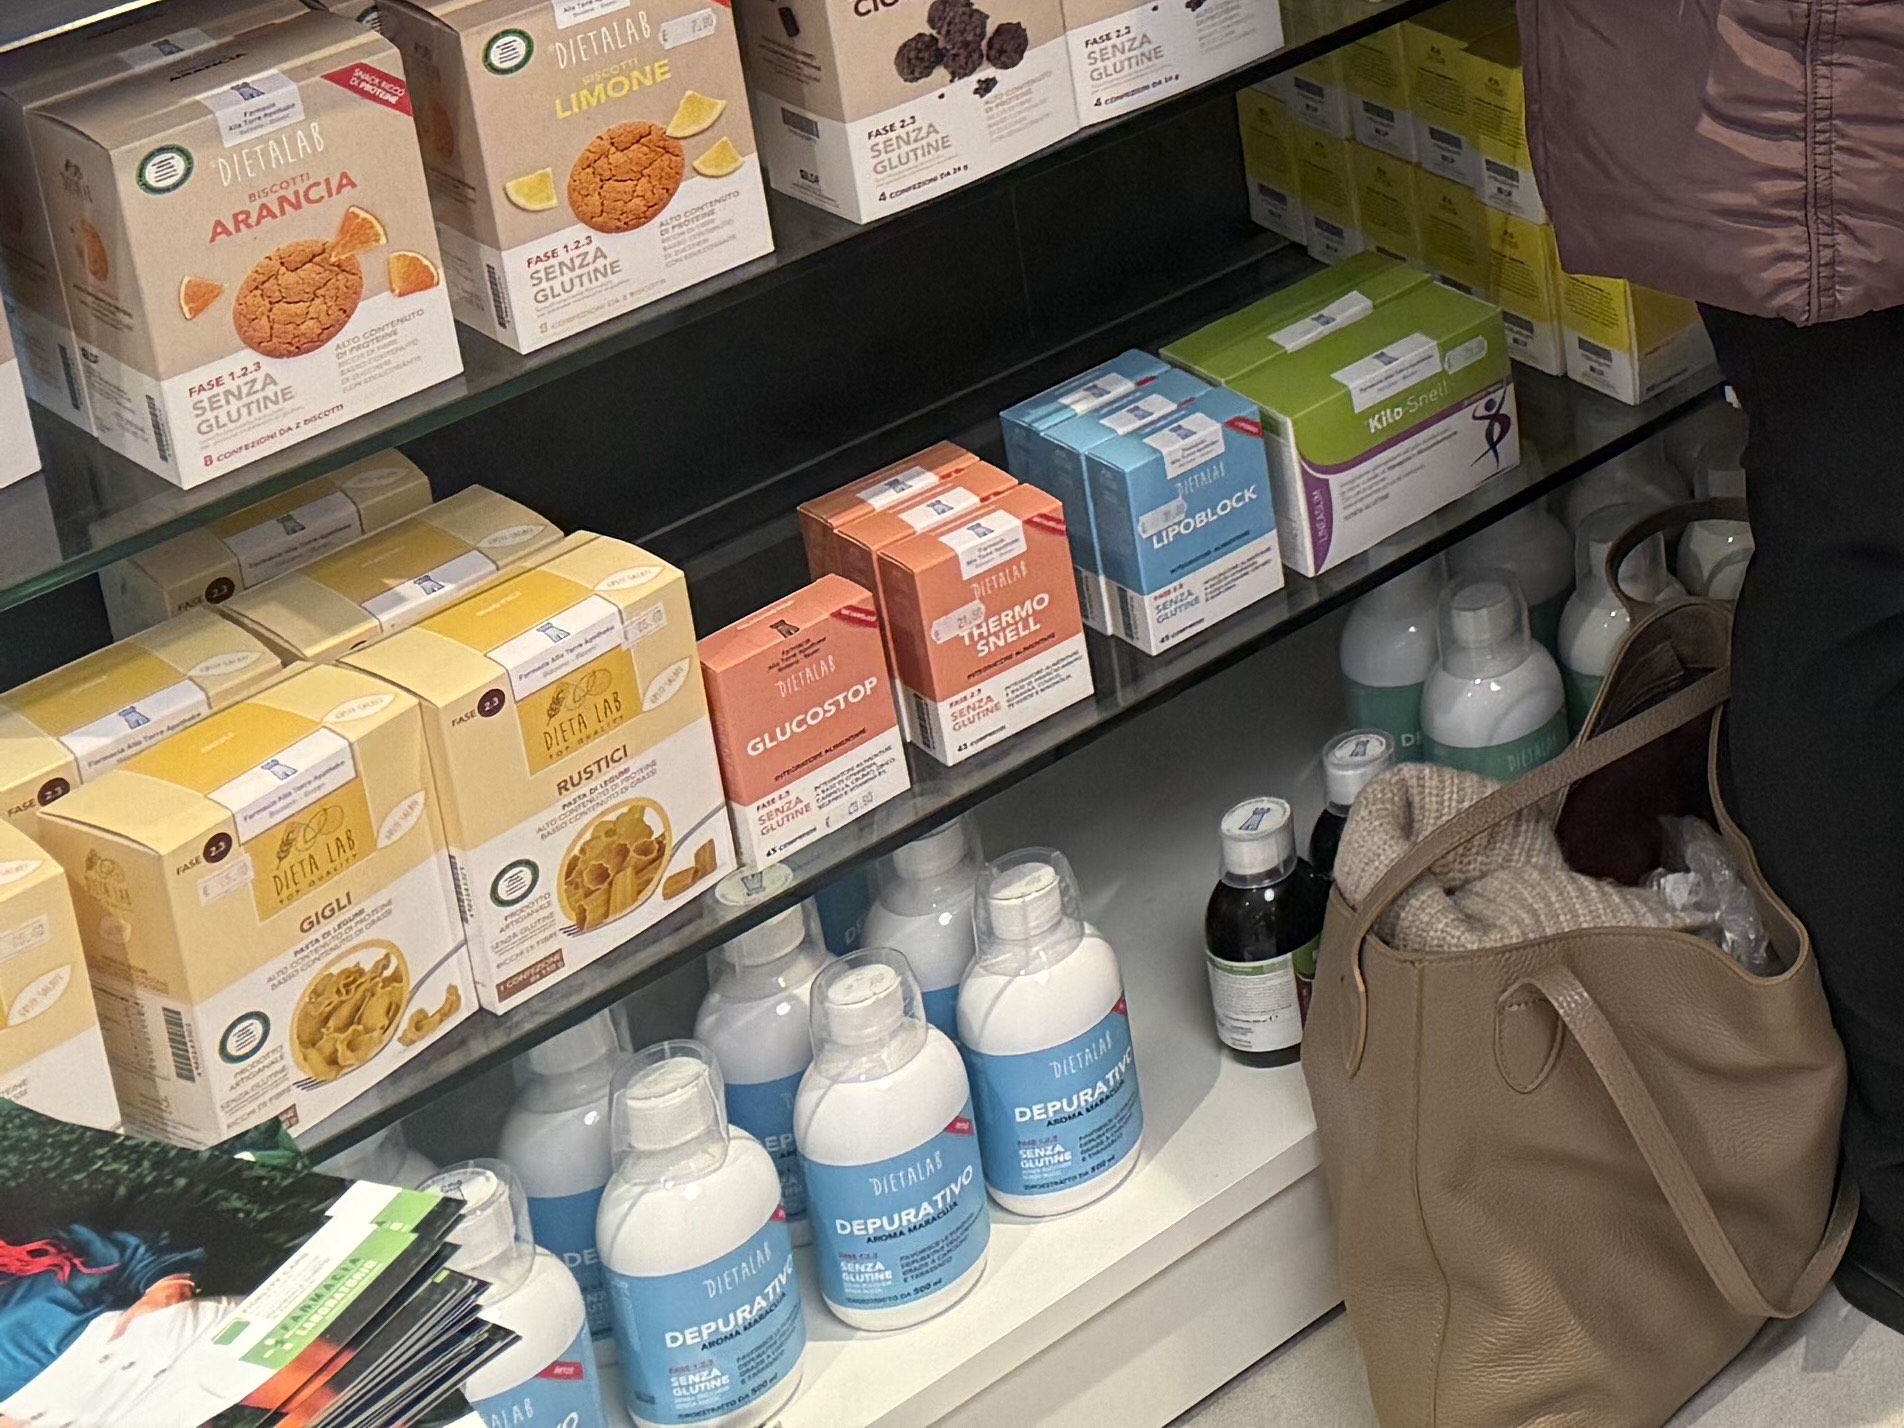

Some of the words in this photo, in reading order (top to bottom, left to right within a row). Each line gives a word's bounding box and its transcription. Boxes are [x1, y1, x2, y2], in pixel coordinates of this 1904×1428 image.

[555, 59, 672, 120] LIMONE
[209, 171, 357, 243] ARANCIA
[1149, 481, 1258, 549] LIPOBLOCK
[958, 593, 1051, 648] THERMO
[975, 617, 1040, 659] SNELL
[745, 674, 879, 758] GLUCOSTOP
[556, 744, 629, 794] RUSTICI
[298, 893, 354, 934] GIGLI
[835, 1165, 974, 1236] DEPURATIVO
[871, 1153, 942, 1197] DIETALAB
